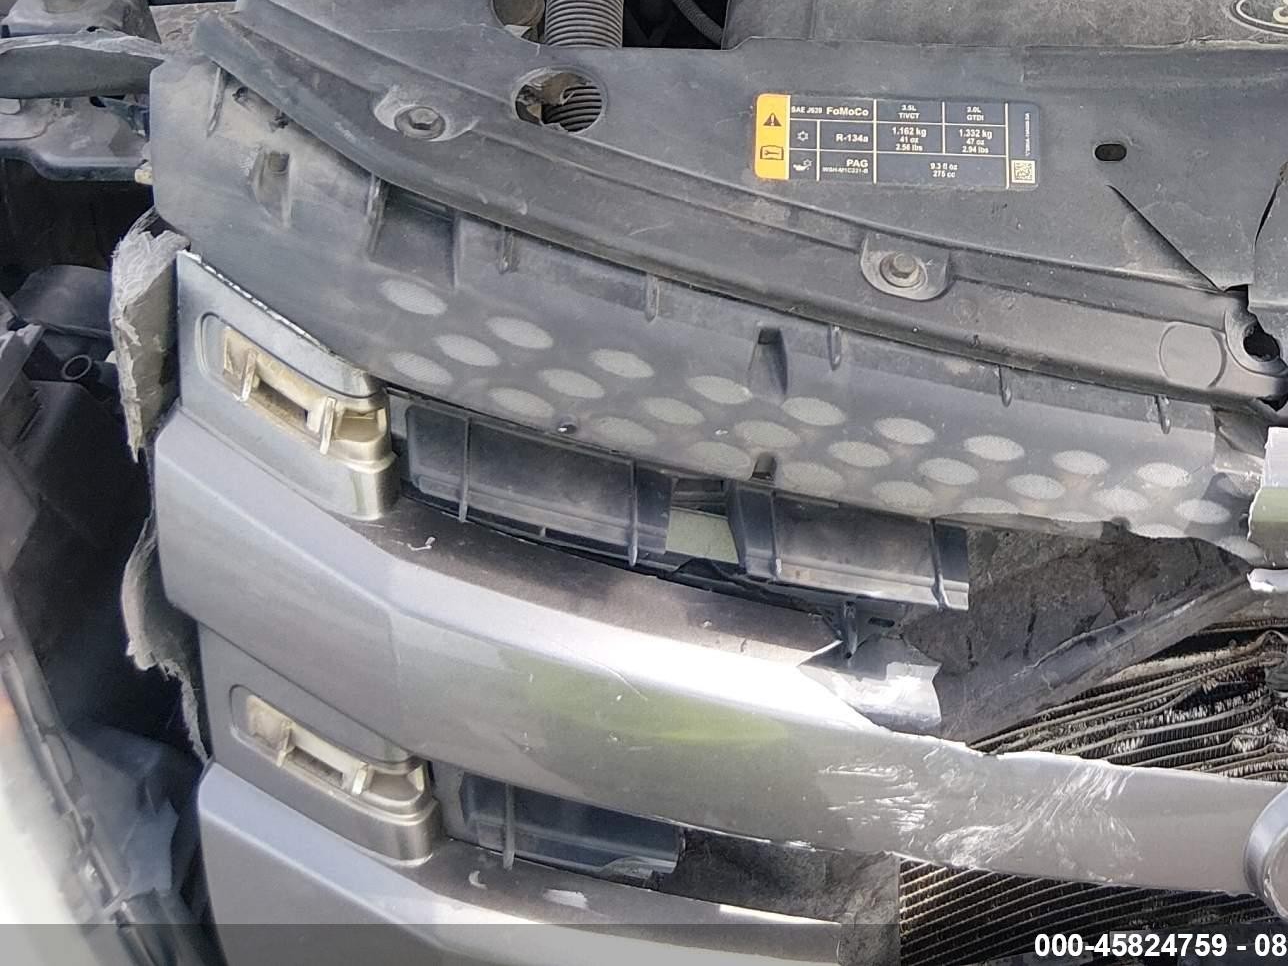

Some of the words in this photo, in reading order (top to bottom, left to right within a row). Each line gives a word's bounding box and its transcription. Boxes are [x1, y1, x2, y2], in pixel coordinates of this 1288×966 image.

[791, 106, 806, 114] SAE
[826, 106, 869, 116] FoMoCo
[891, 127, 914, 136] 1.162
[915, 127, 927, 137] kg
[959, 128, 980, 138] 1.332
[981, 129, 993, 140] kg
[835, 133, 869, 143] R-134a
[899, 136, 909, 144] 41
[965, 138, 975, 146] 47
[911, 143, 923, 152] lbs
[977, 146, 989, 154] lbs
[846, 159, 869, 168] PAG
[930, 162, 942, 170] 9.3
